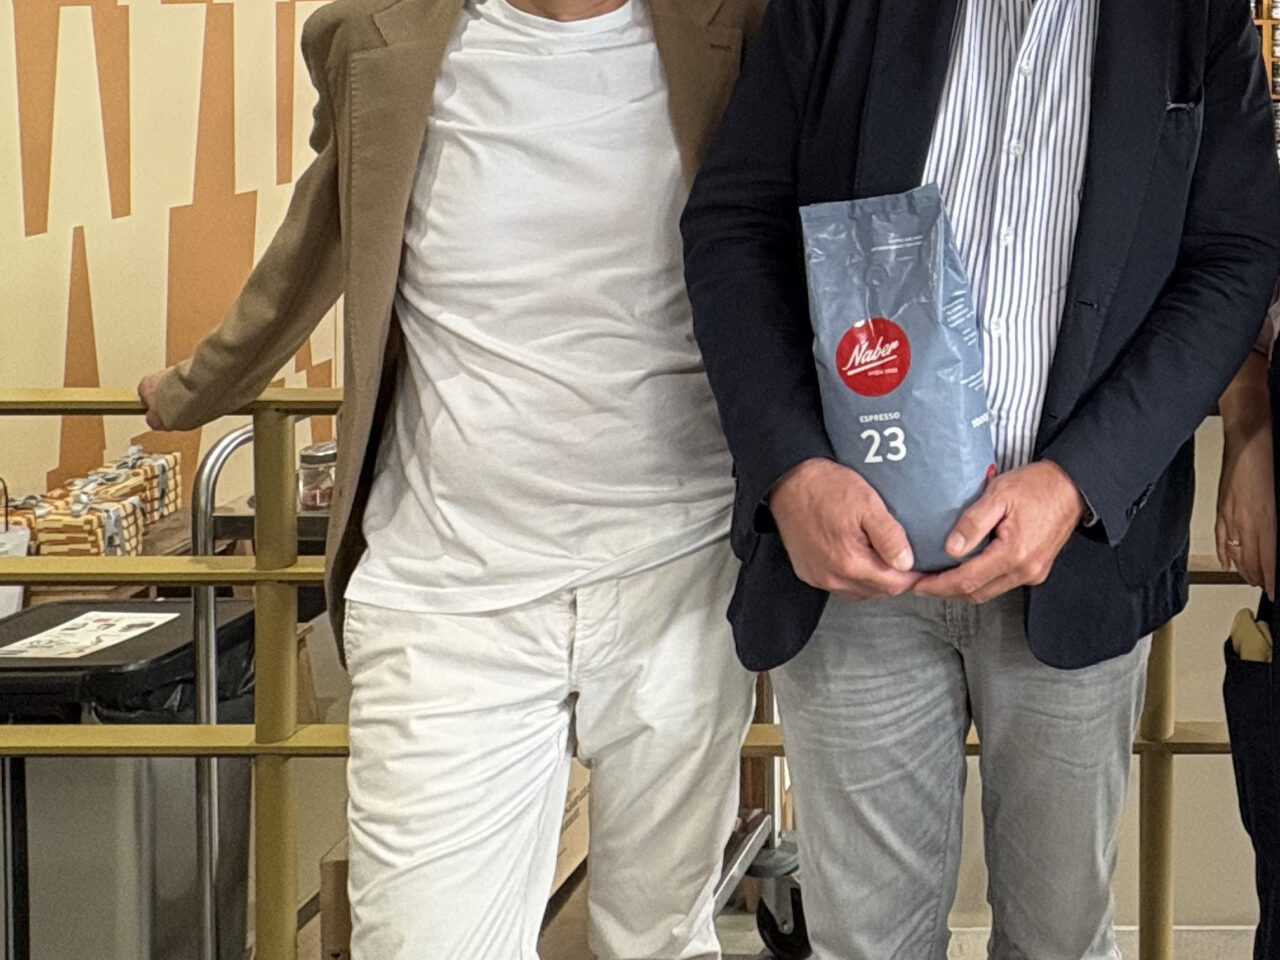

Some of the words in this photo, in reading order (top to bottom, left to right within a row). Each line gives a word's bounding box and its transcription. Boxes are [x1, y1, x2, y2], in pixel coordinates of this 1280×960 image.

[841, 335, 900, 371] Naber
[859, 411, 901, 423] ESPRESSO
[860, 426, 907, 464] 23
